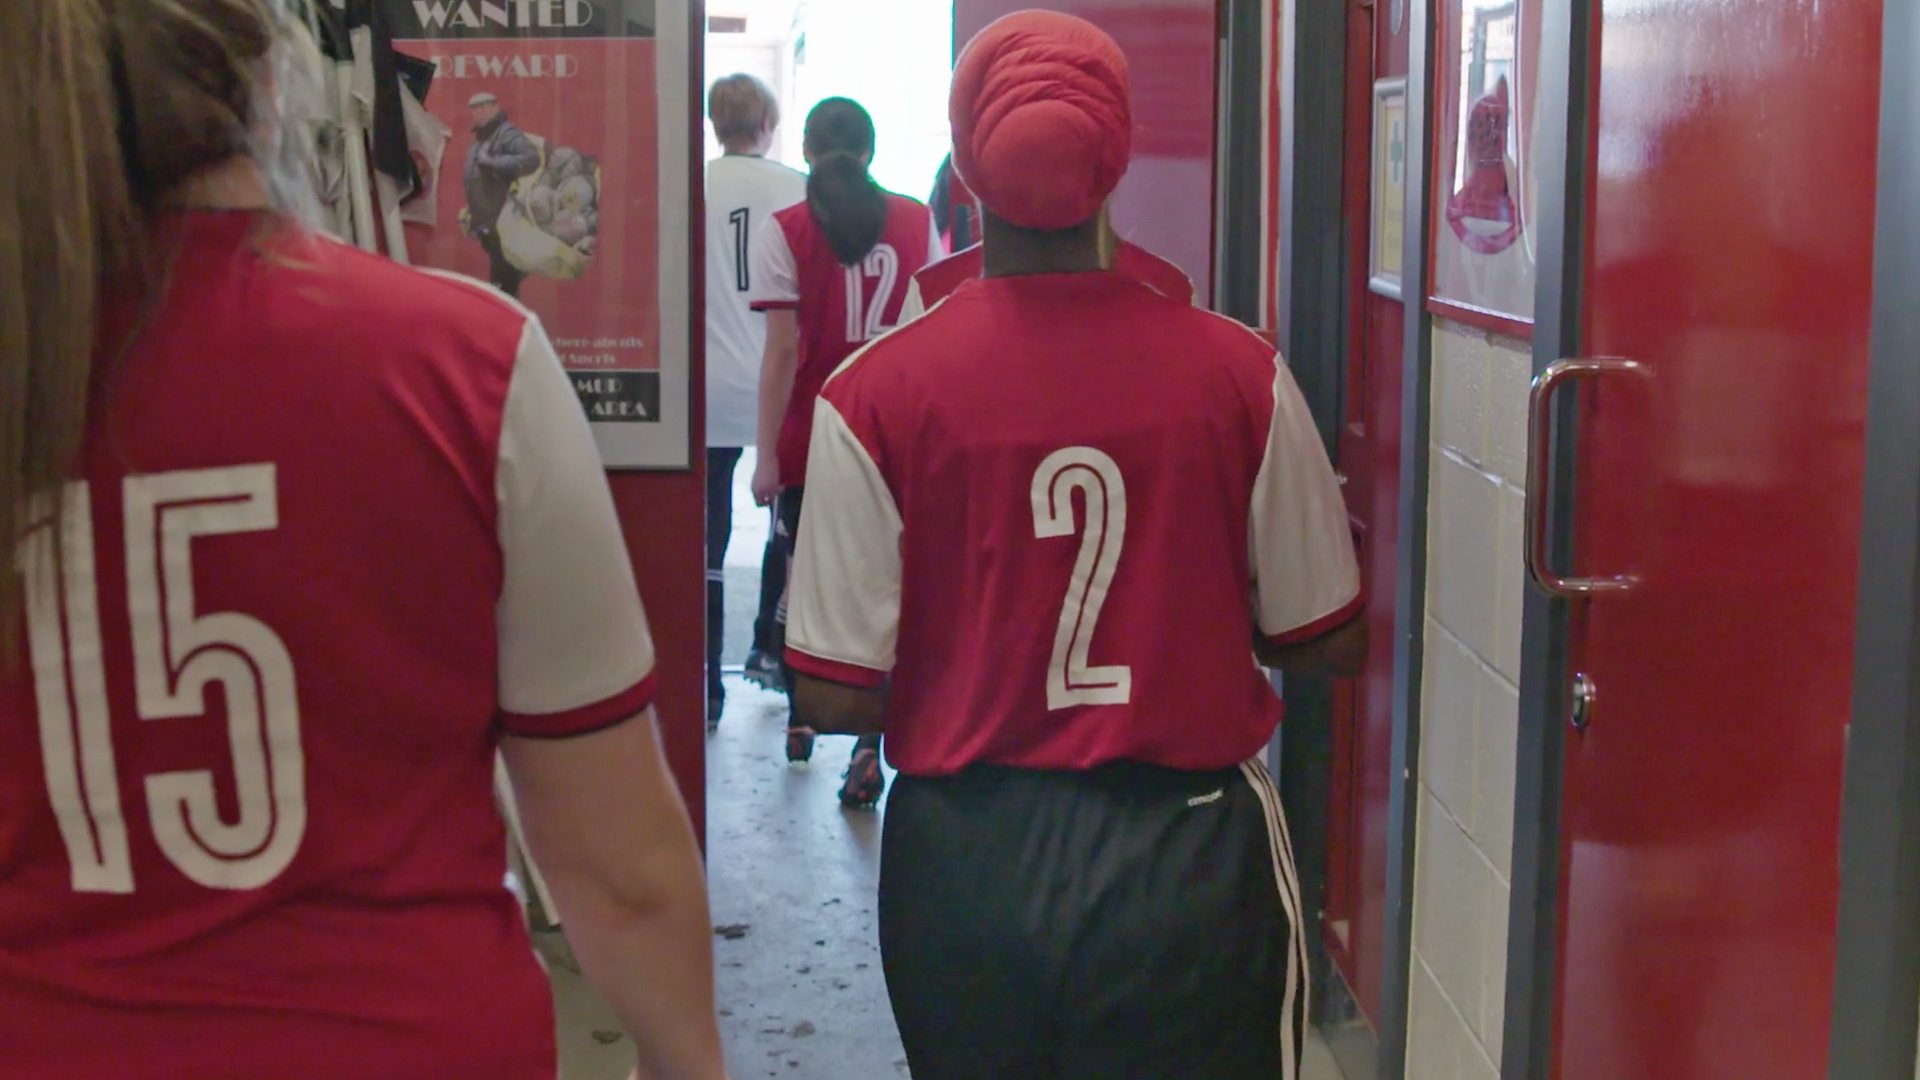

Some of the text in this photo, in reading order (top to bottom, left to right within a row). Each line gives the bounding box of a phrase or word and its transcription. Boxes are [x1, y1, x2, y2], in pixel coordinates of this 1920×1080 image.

[411, 0, 593, 29] WANTED
[430, 53, 578, 79] REWARD
[729, 207, 750, 292] 1
[837, 243, 899, 343] 12
[591, 401, 648, 417] AREA
[1030, 446, 1132, 711] 2
[15, 462, 308, 893] 15
